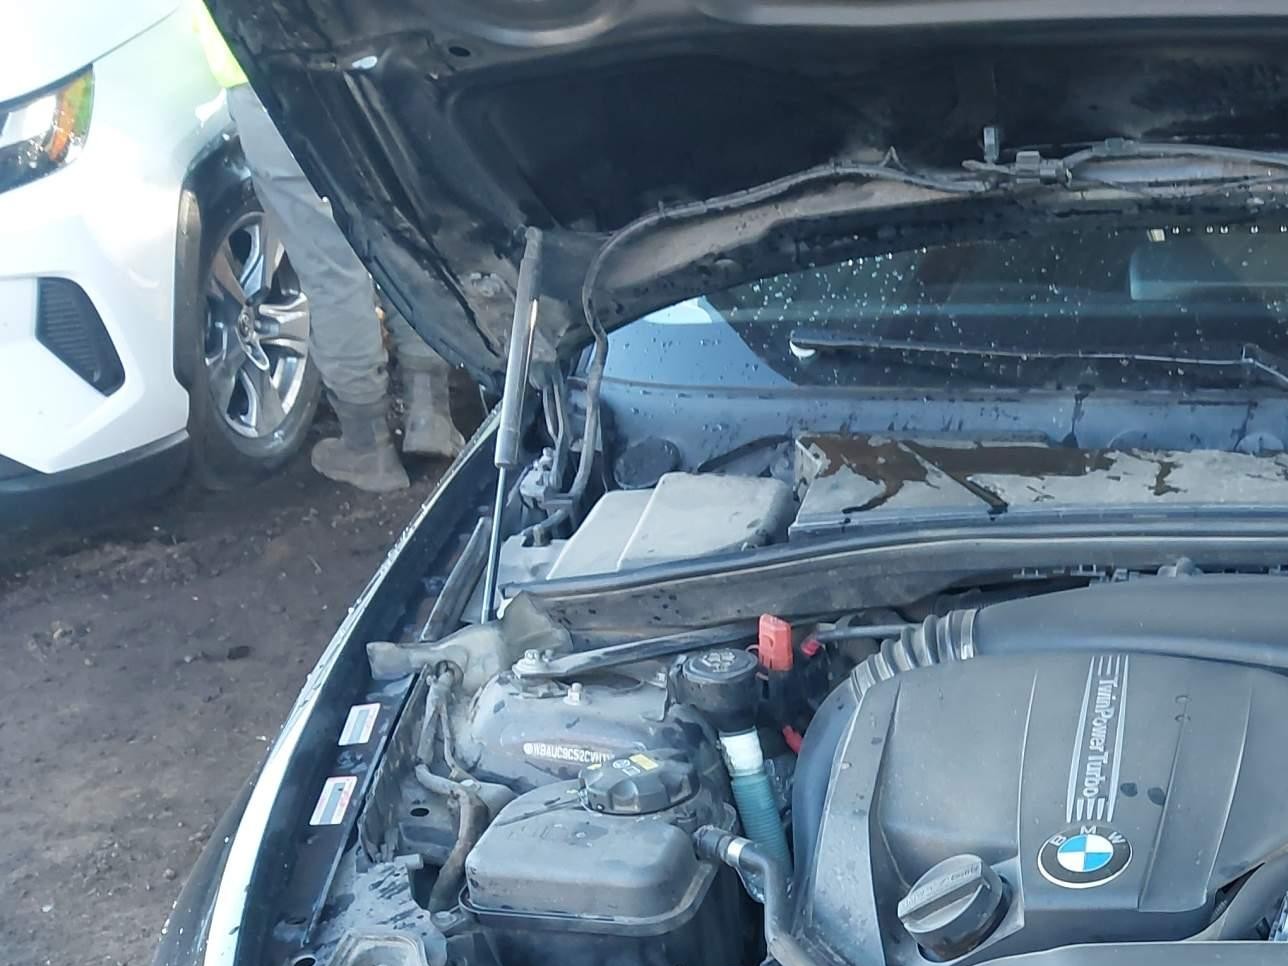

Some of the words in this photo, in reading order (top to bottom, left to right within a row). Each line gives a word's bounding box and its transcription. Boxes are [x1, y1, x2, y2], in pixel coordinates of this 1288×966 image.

[1089, 678, 1118, 752] TwinPower
[1083, 751, 1108, 798] Turbo
[1048, 825, 1126, 846] BMW
